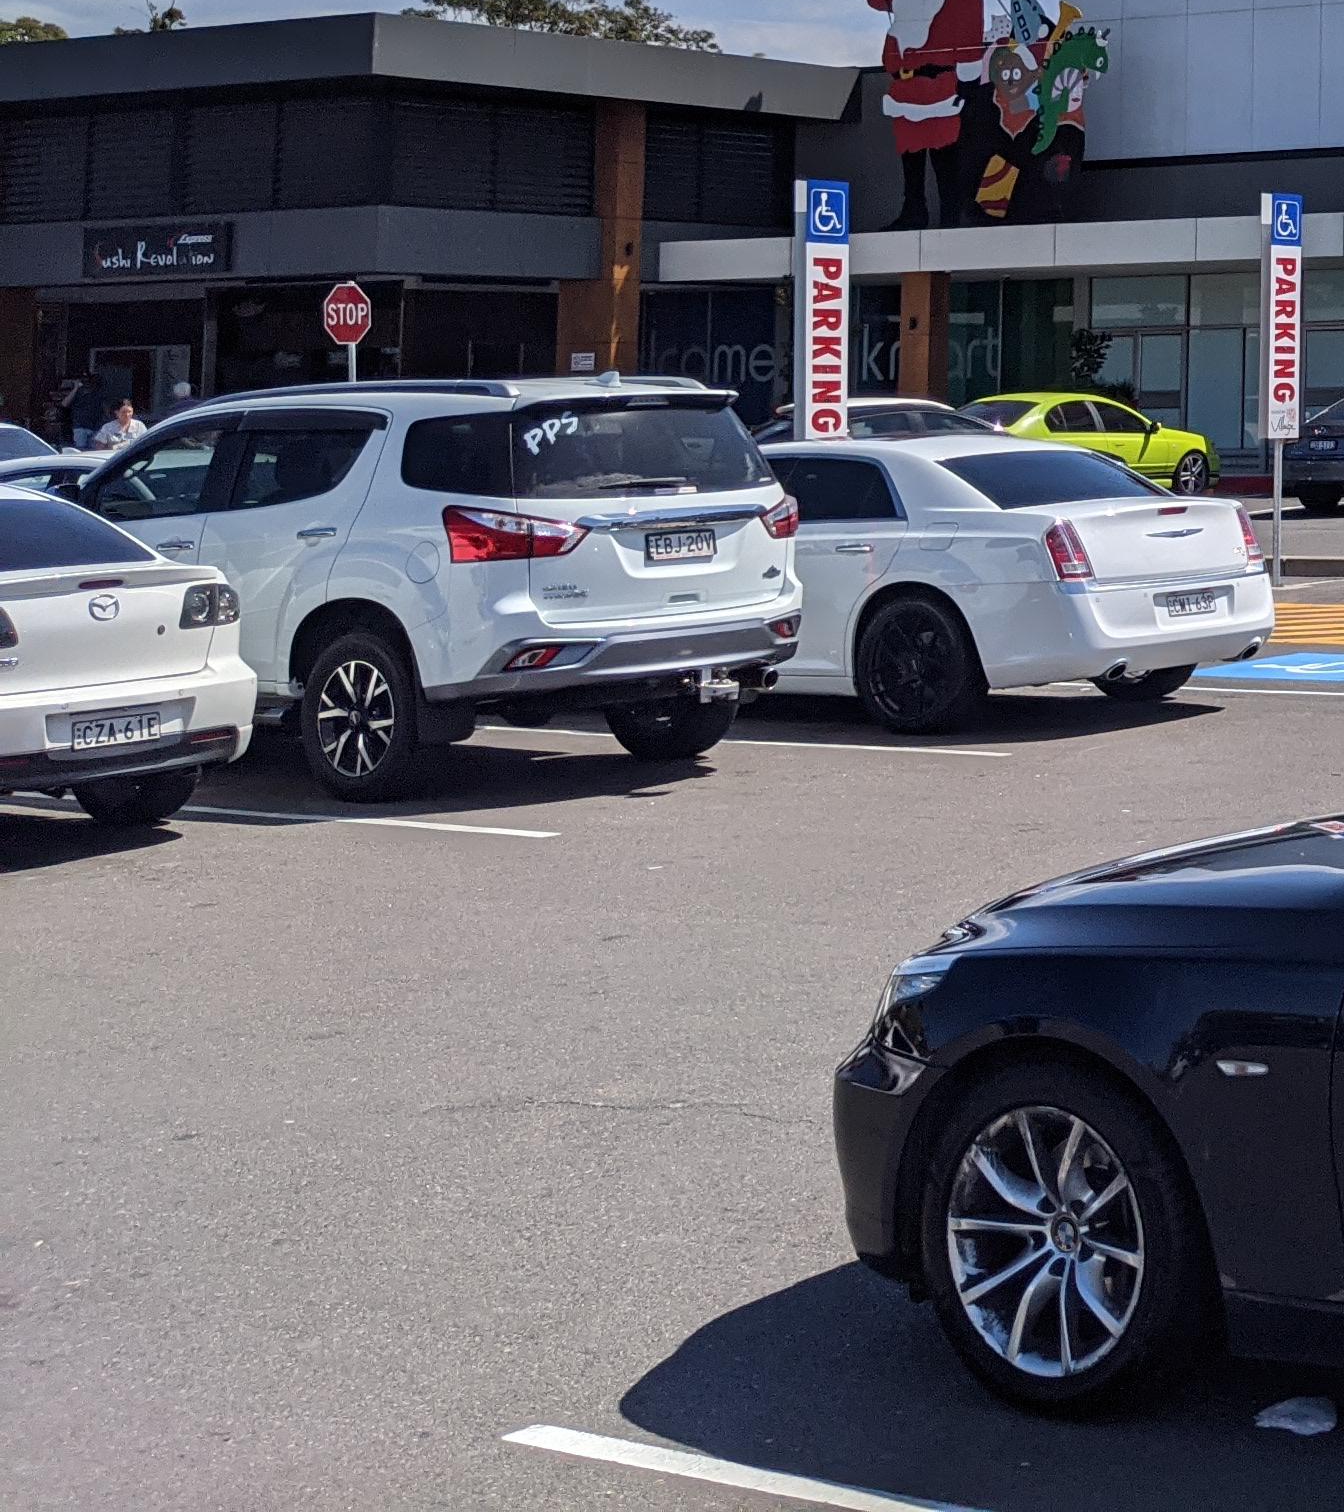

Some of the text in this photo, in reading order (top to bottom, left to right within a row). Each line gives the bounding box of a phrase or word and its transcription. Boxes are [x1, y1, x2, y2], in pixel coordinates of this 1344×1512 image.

[328, 303, 367, 325] STOP
[812, 257, 842, 433] PARKING
[1273, 258, 1297, 403] PARKING
[524, 411, 579, 456] PPS
